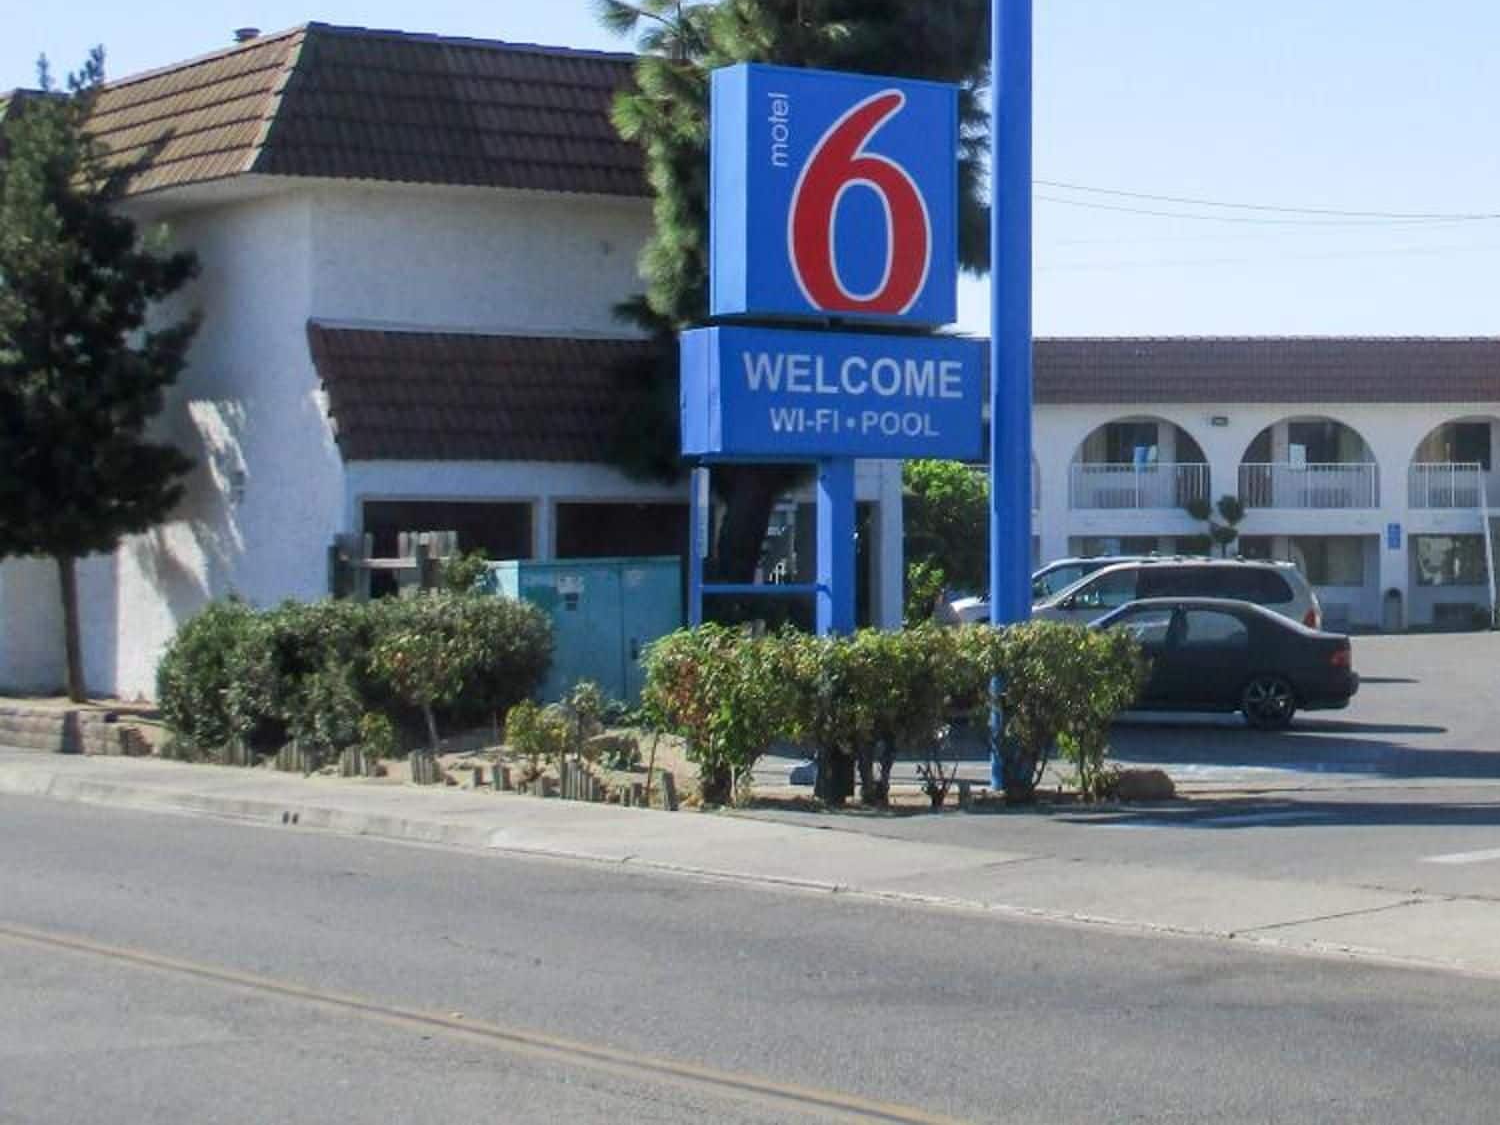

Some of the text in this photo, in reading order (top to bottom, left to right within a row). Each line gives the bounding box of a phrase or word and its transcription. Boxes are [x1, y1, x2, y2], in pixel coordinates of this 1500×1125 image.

[768, 89, 932, 315] motel 6
[743, 351, 964, 398] WELCOME
[769, 407, 940, 437] WI-FI POOL
